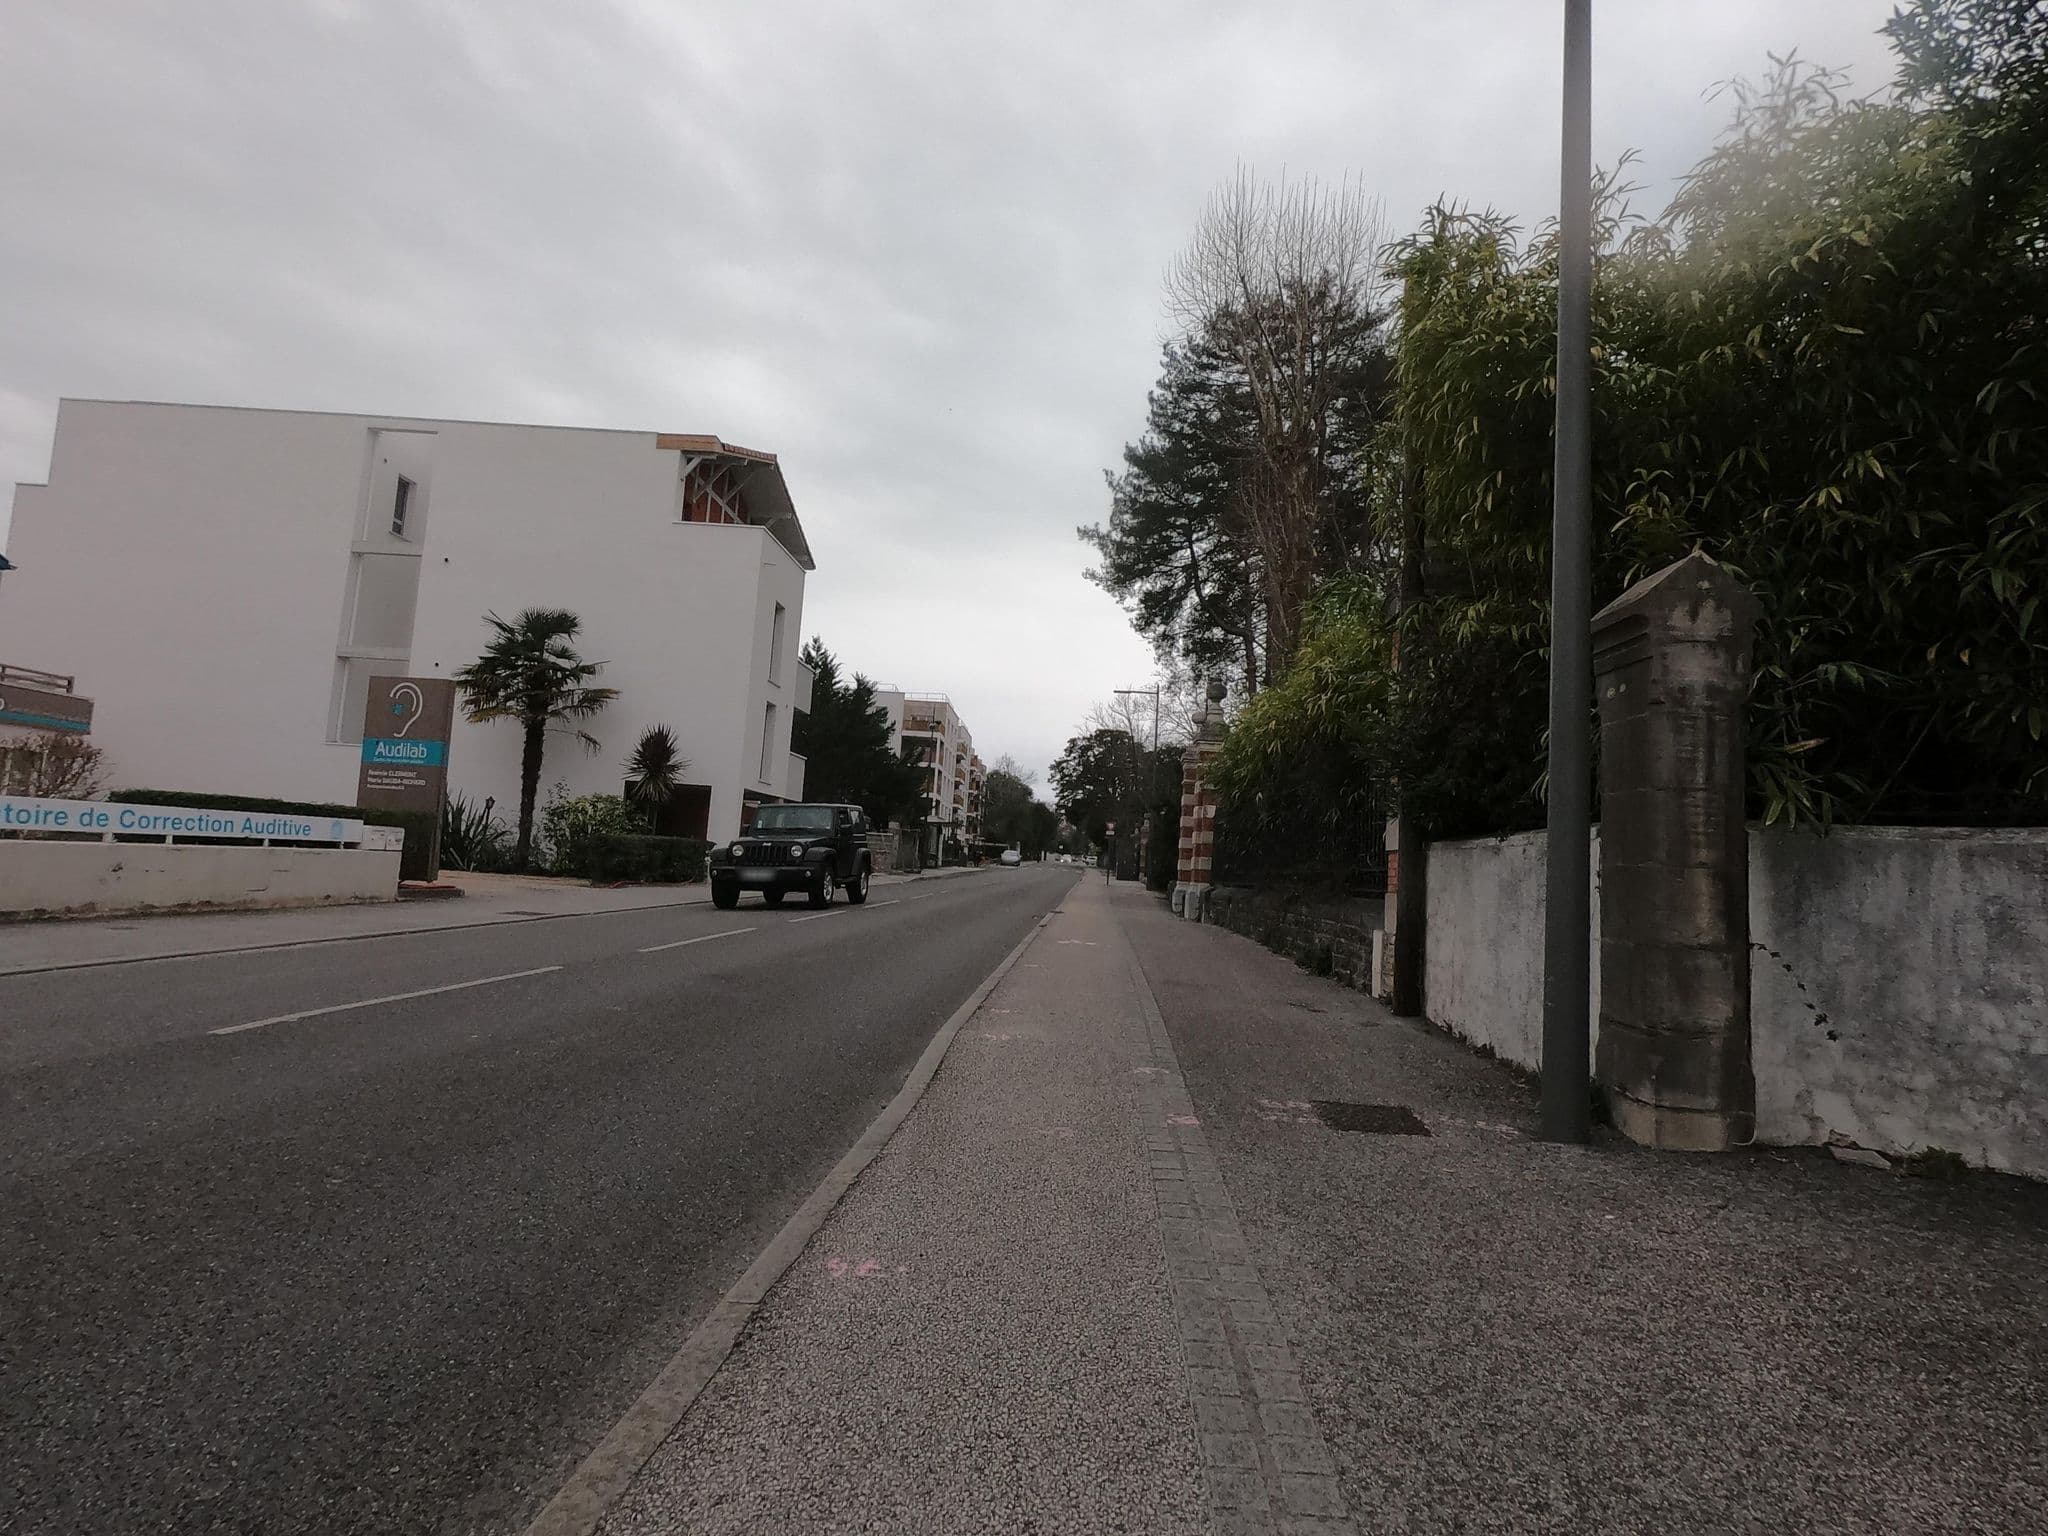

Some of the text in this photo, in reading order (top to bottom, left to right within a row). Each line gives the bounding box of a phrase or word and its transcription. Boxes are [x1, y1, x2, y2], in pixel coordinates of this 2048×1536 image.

[375, 741, 428, 759] Audilab
[0, 803, 312, 837] toire de Correction Auditive
